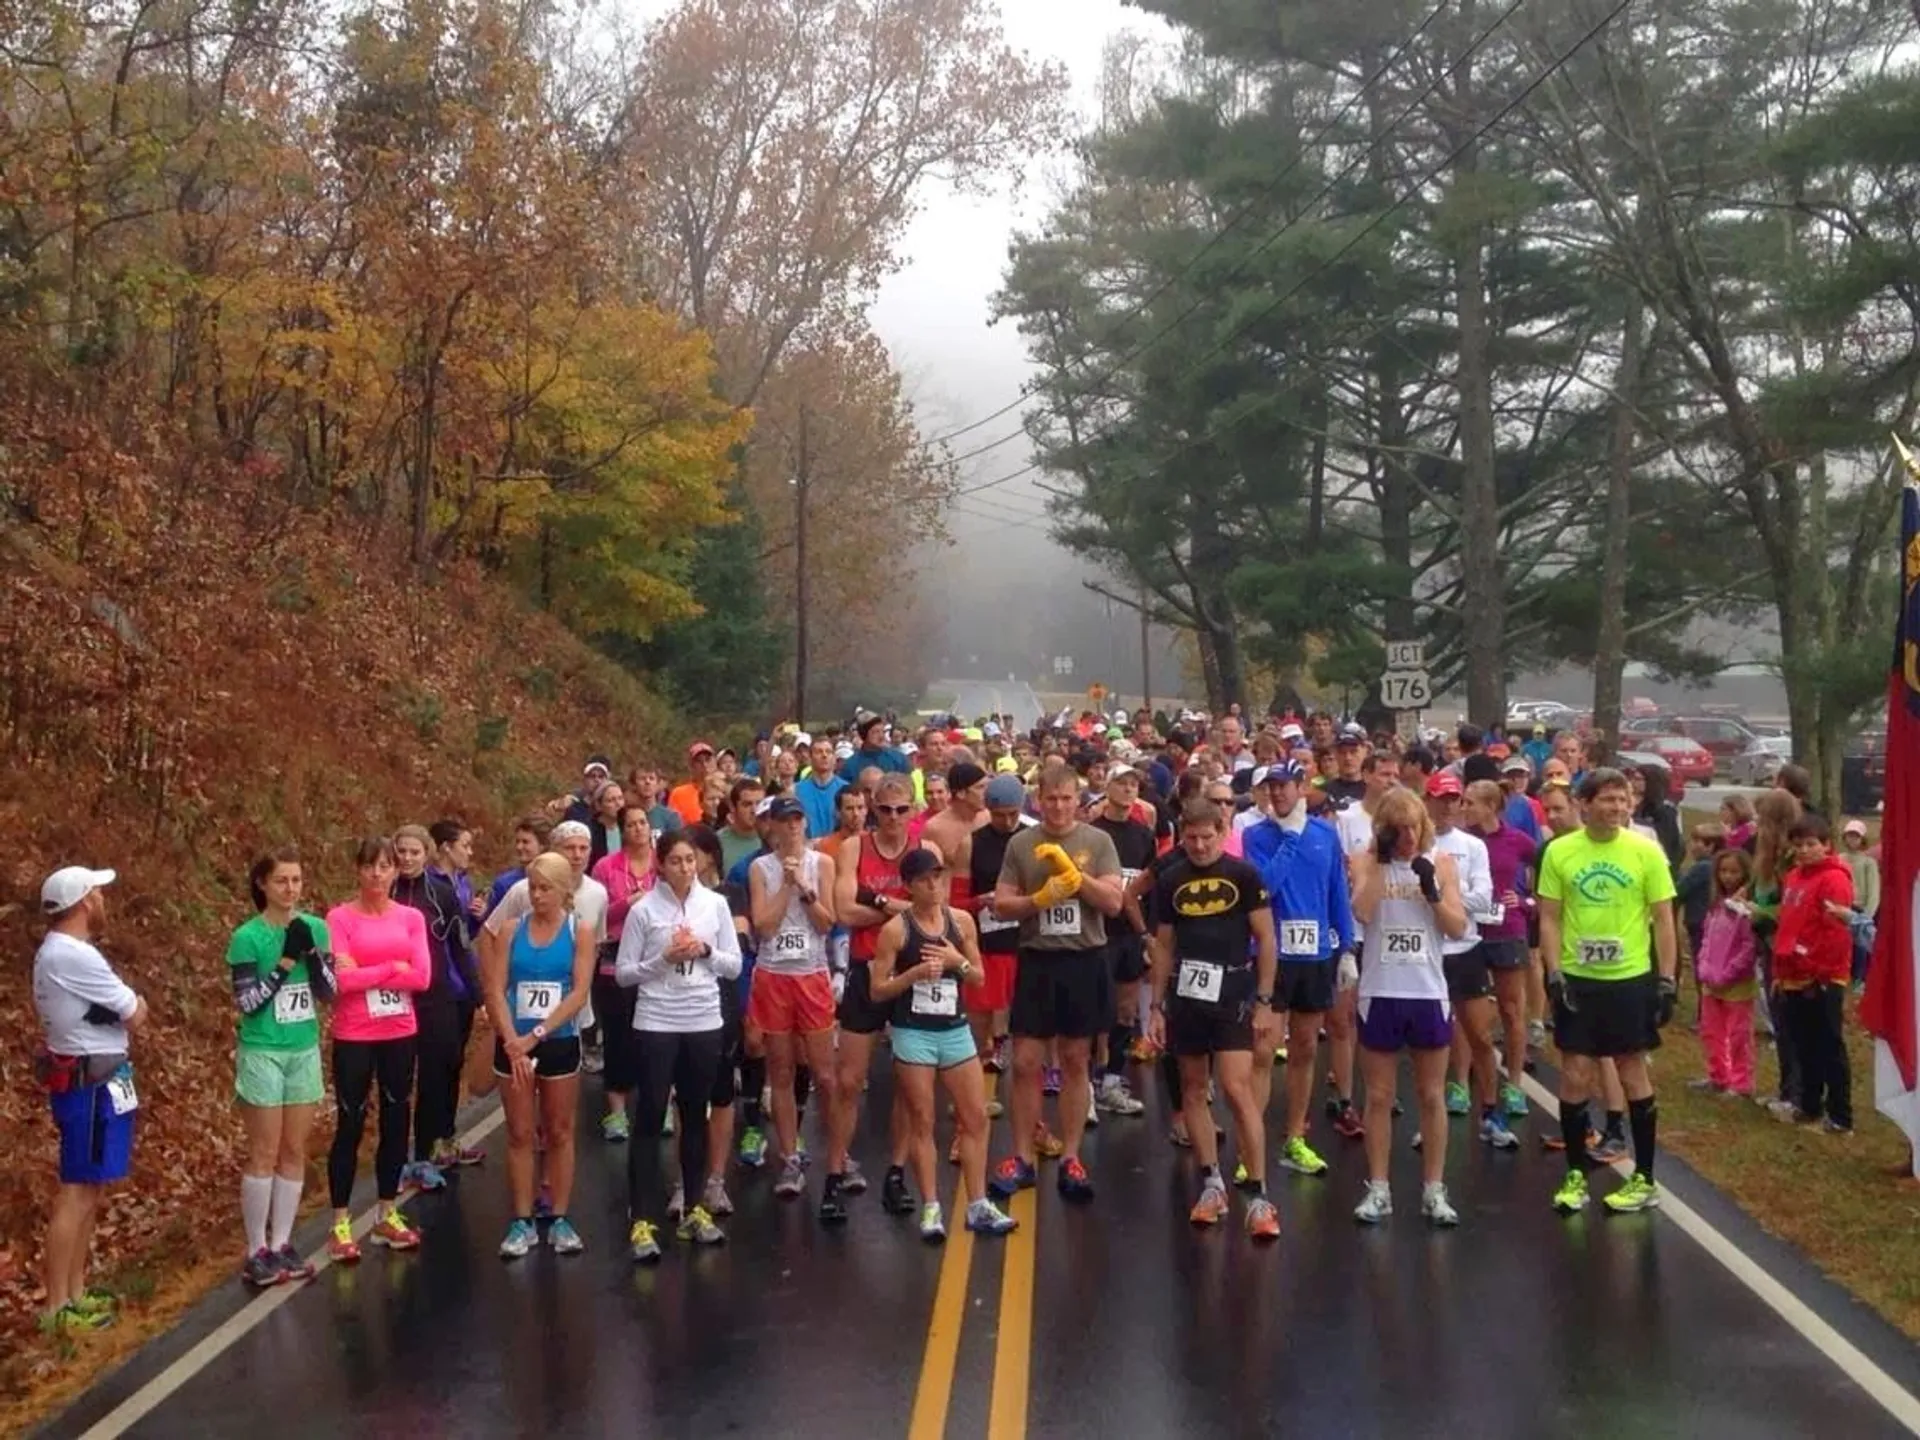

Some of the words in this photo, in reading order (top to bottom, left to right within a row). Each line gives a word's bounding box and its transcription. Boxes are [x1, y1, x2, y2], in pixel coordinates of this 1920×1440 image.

[1390, 645, 1420, 664] JCT
[1386, 677, 1425, 700] 176
[775, 933, 805, 952] 265
[1287, 927, 1316, 945] 175
[1388, 933, 1422, 953] 250
[1188, 968, 1210, 989] 79
[287, 990, 310, 1012] 76
[527, 989, 550, 1009] 70
[931, 986, 942, 1004] 5
